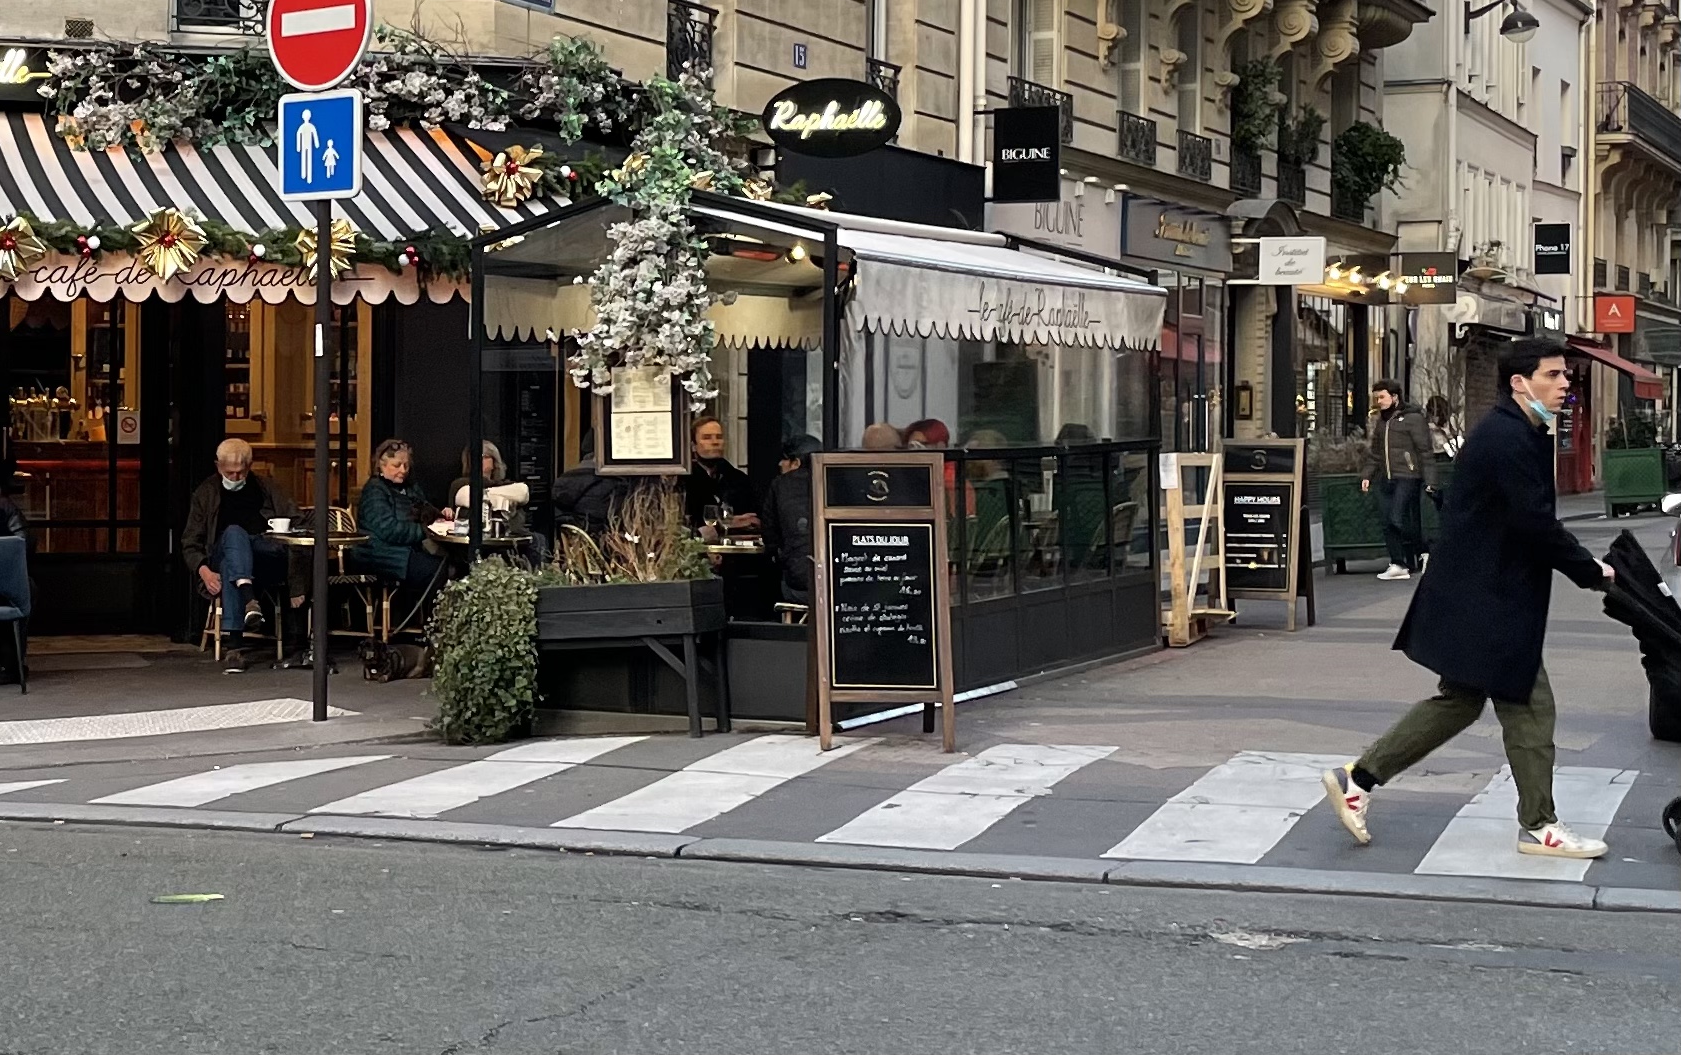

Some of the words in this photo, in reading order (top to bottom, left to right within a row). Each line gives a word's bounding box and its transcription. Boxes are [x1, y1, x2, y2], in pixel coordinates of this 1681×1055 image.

[1001, 146, 1051, 161] BIGUINE
[1034, 200, 1085, 237] BIGUINE
[115, 258, 151, 285] de
[852, 535, 875, 545] PLATS
[876, 535, 887, 545] DU
[889, 535, 909, 546] JOUR
